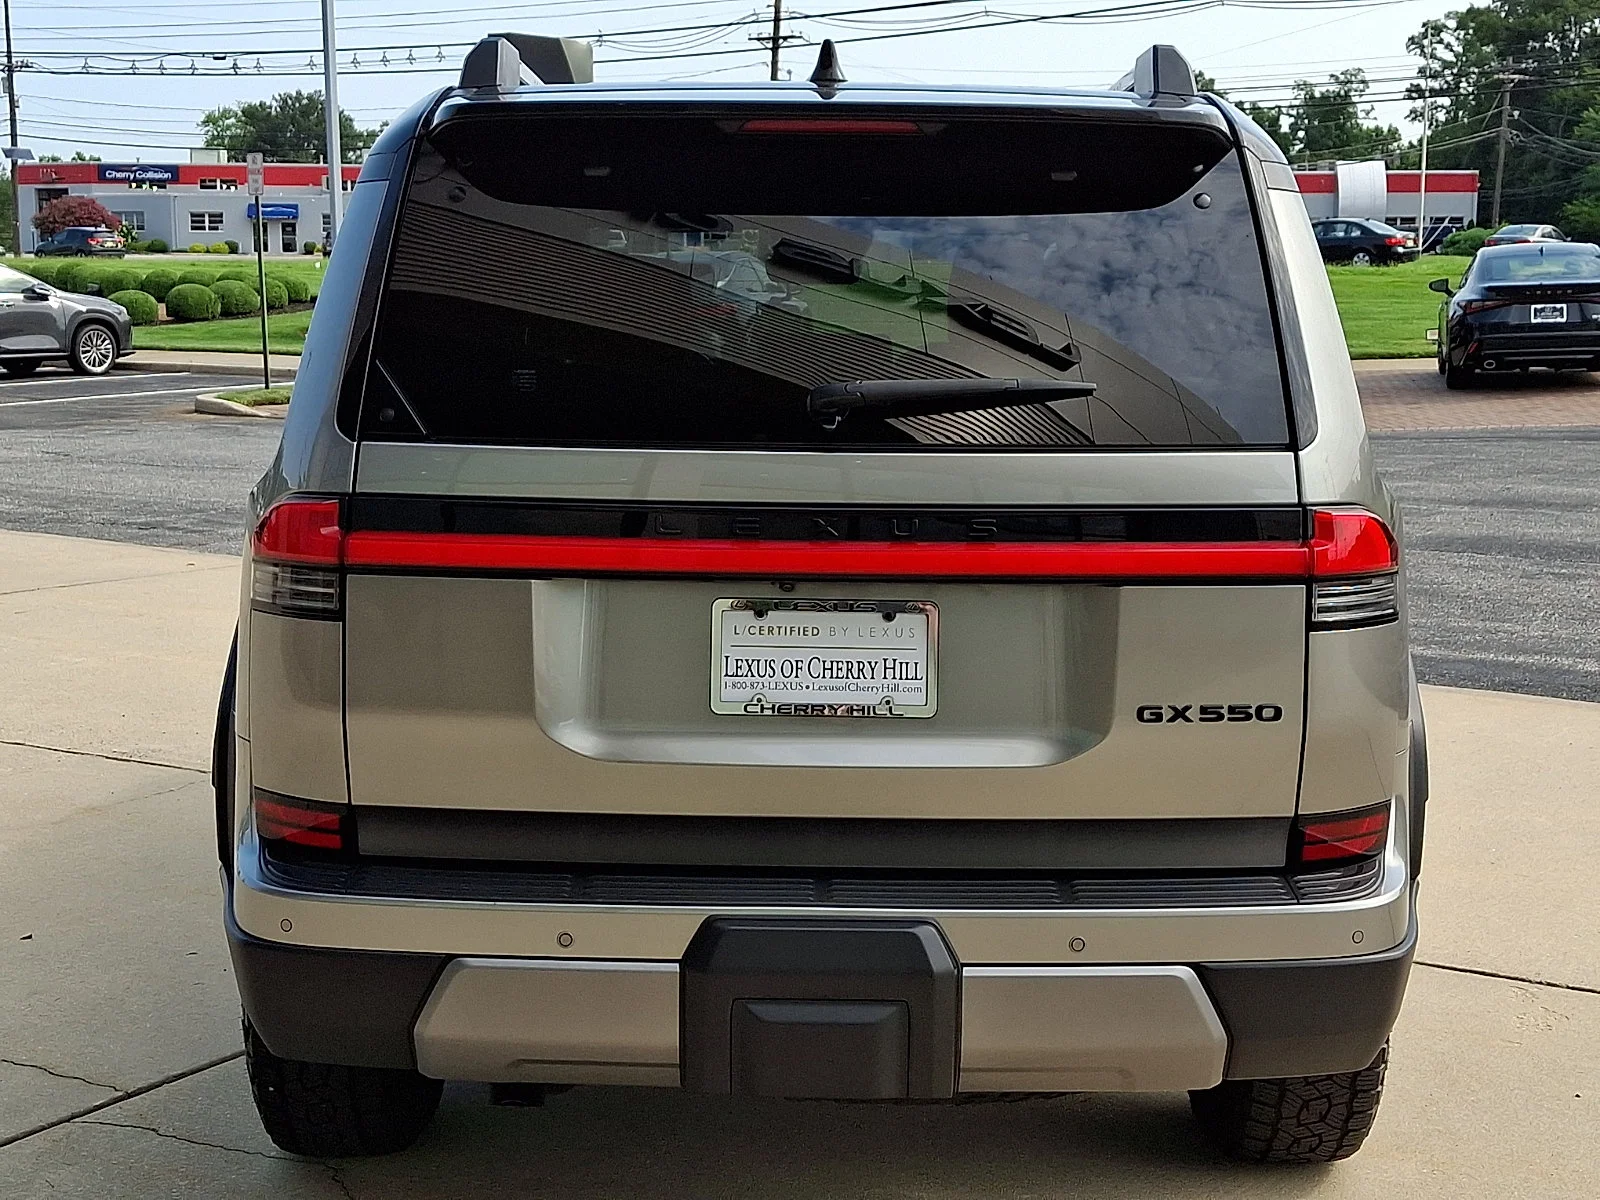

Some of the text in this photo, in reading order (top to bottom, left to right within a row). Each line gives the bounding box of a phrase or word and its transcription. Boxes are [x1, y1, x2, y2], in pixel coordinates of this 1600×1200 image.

[105, 170, 172, 181] Cherry Collision
[655, 513, 998, 537] LEXUS
[773, 601, 877, 613] LEXUS
[733, 625, 916, 638] L/CERTIFIED BY LEXUS
[724, 655, 777, 678] LEXUS
[807, 656, 879, 680] CHERRY
[882, 658, 924, 681] HILL
[743, 703, 905, 717] CHERRY HILL
